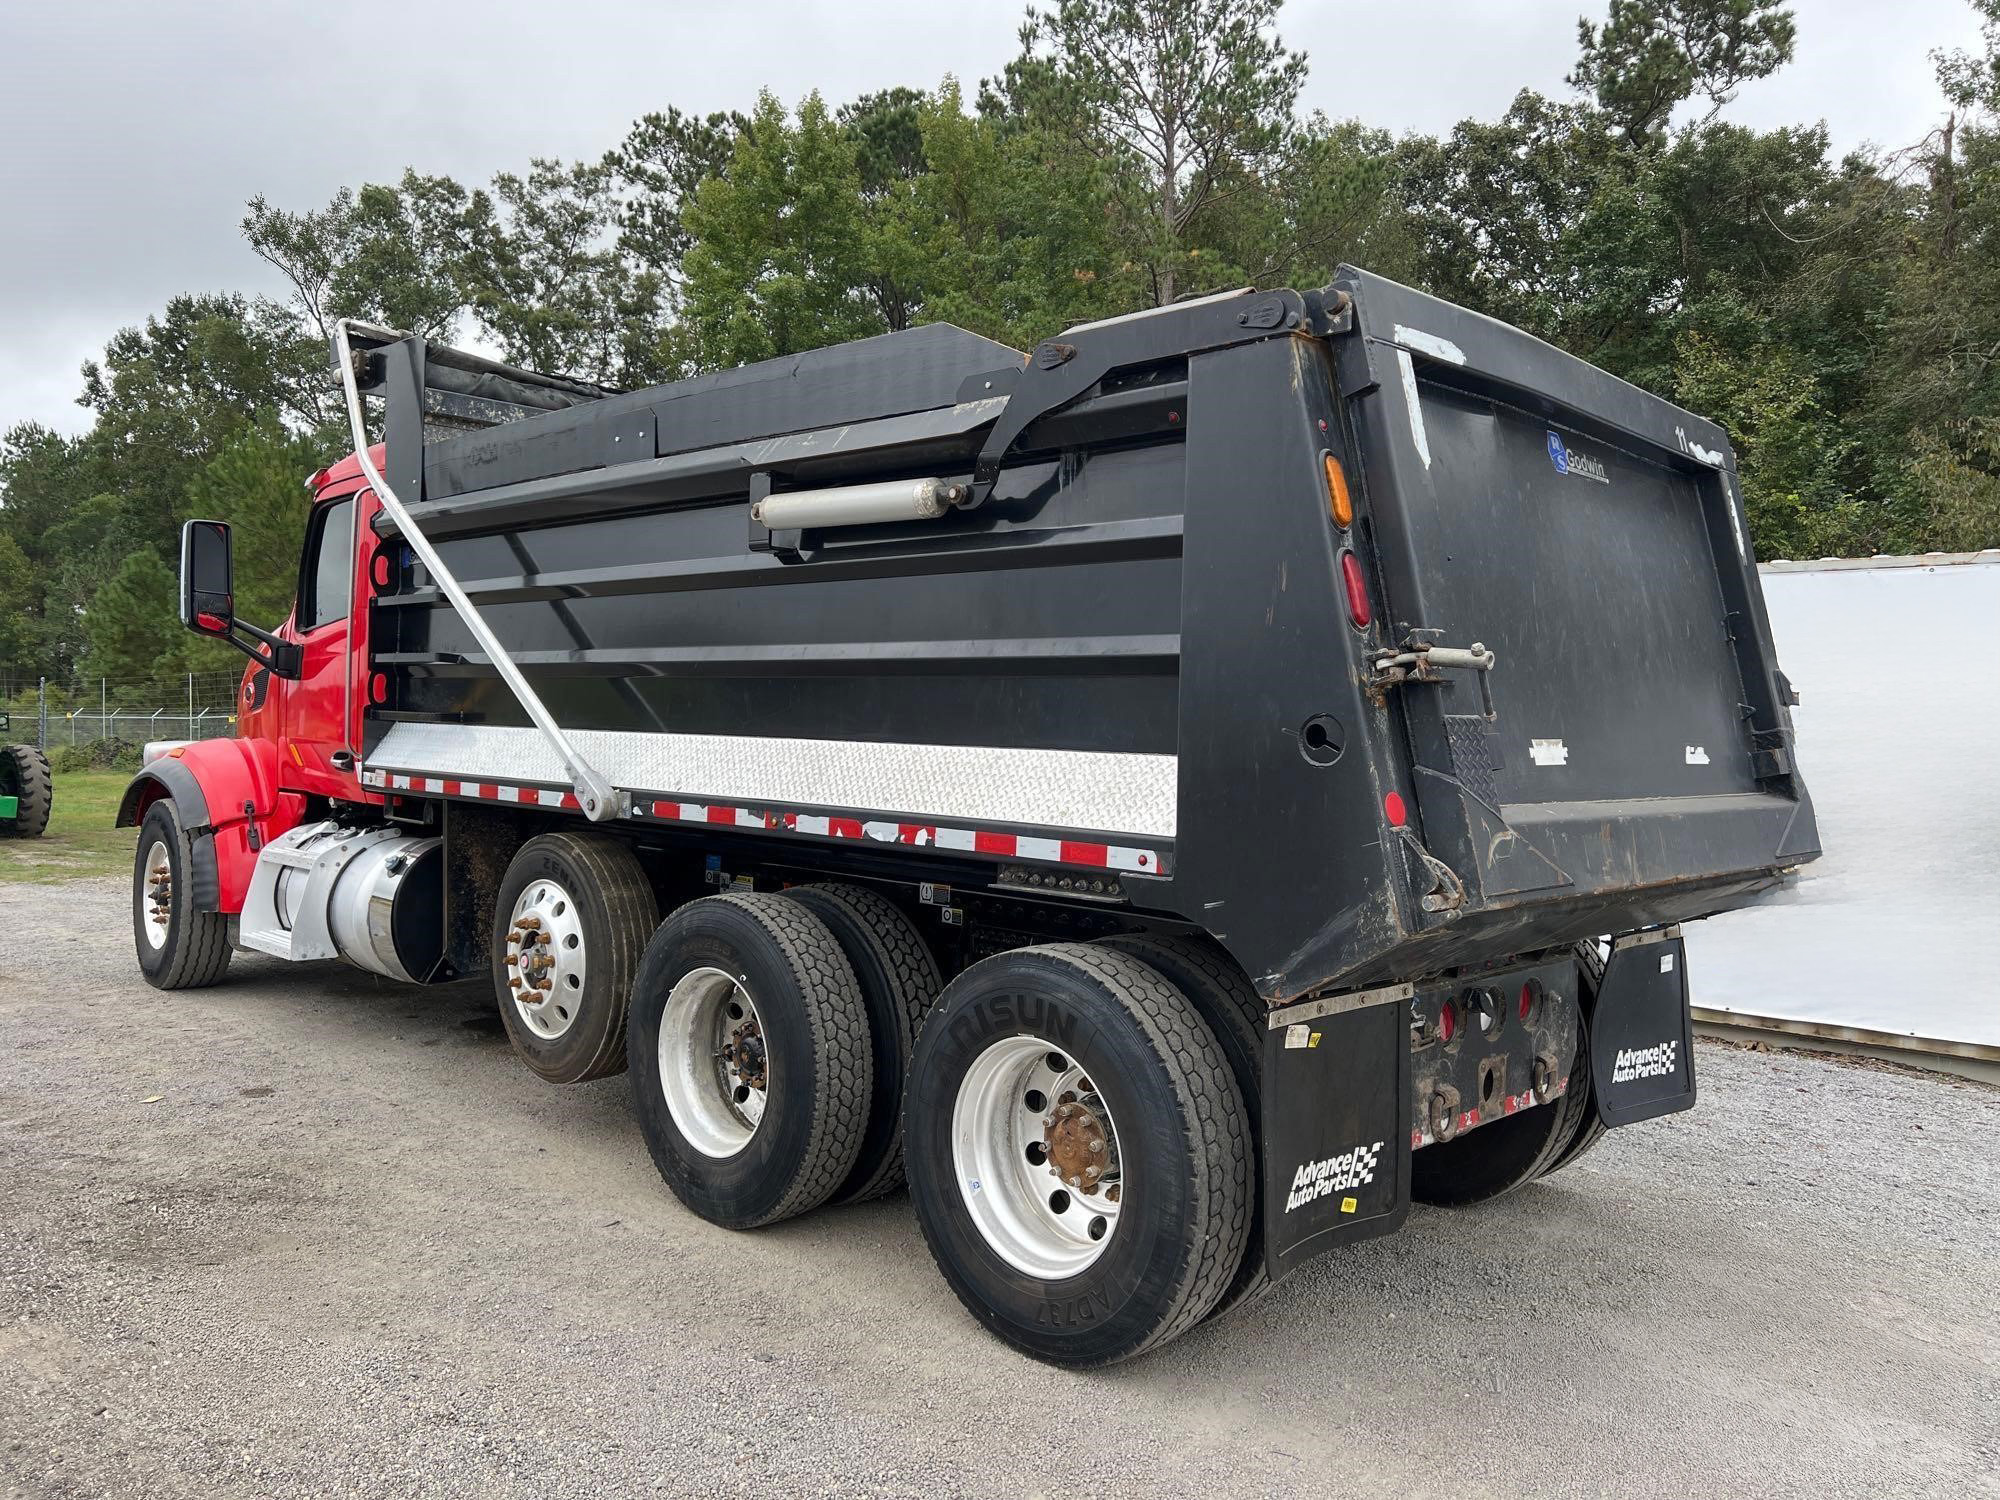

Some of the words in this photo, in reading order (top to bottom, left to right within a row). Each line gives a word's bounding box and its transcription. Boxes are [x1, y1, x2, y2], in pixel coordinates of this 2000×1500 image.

[1566, 448, 1605, 478] Godwin
[1615, 1046, 1659, 1068] Advance
[1291, 1153, 1352, 1191] Advance
